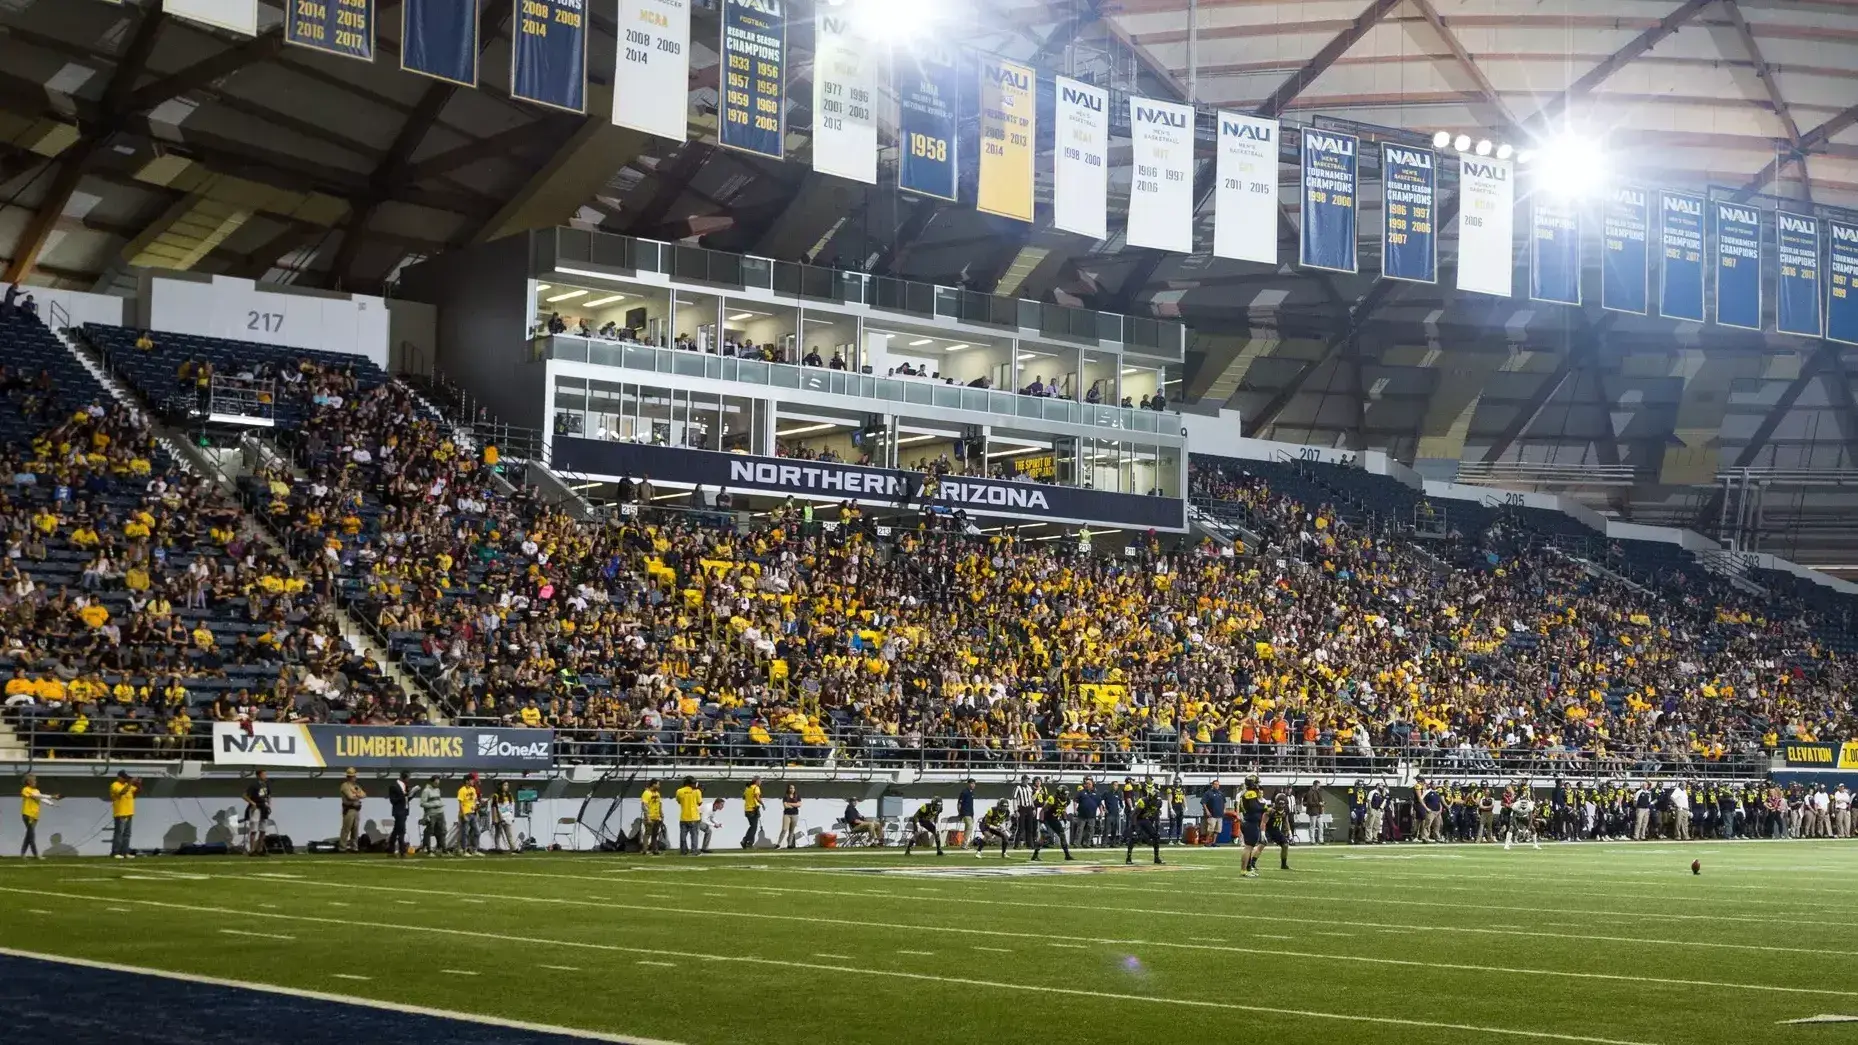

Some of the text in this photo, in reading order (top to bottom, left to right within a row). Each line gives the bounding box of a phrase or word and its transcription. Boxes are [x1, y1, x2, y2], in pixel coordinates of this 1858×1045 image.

[297, 0, 326, 20] 2014
[337, 9, 365, 29] 2015
[522, 0, 549, 19] 2008
[555, 8, 581, 28] 2009
[297, 20, 362, 49] 2016 2017
[522, 18, 547, 37] 2014
[626, 28, 681, 55] 2008 2009
[727, 26, 780, 49] REGULAR SEASON
[625, 47, 648, 64] 2014
[726, 36, 780, 62] CHAMPIONS
[728, 53, 779, 79] 1933 1956
[727, 71, 750, 89] 1957
[984, 64, 1029, 91] NAU
[824, 81, 842, 96] 1977
[727, 89, 778, 114] 1959 1960
[1062, 86, 1102, 112] NAU
[755, 115, 778, 132] 2003
[823, 115, 842, 131] 2013
[1137, 106, 1186, 128] NAU
[1010, 132, 1027, 147] 2013
[1222, 121, 1270, 142] NAU
[910, 132, 947, 162] 1958
[985, 142, 1004, 156] 2014
[1306, 134, 1353, 155] NAU
[1084, 152, 1101, 167] 2000
[1386, 148, 1431, 169] NAU
[1165, 169, 1184, 182] 1997
[1307, 167, 1353, 182] TOURNAMENT
[1463, 161, 1506, 181] NAU
[1225, 178, 1270, 195] 2011 2015
[1306, 176, 1353, 193] CHAMPIONS
[1387, 181, 1432, 194] REGULAR SEASON
[1387, 189, 1432, 206] CHAMPIONS
[1663, 196, 1701, 215] NAU
[1720, 206, 1757, 225] NAU
[1780, 216, 1815, 234] NAU
[1663, 234, 1700, 250] CHAMPIONS
[1721, 235, 1757, 248] TOURNAMENT
[1720, 244, 1758, 259] CHAMPIONS
[1780, 253, 1816, 267] CHAMPIONS
[247, 310, 284, 333] 217
[1300, 447, 1321, 462] 207
[1505, 492, 1525, 507] 205
[222, 734, 549, 757] NAU LUMBERJACKS OneAZ
[1787, 746, 1833, 763] ELEVATION
